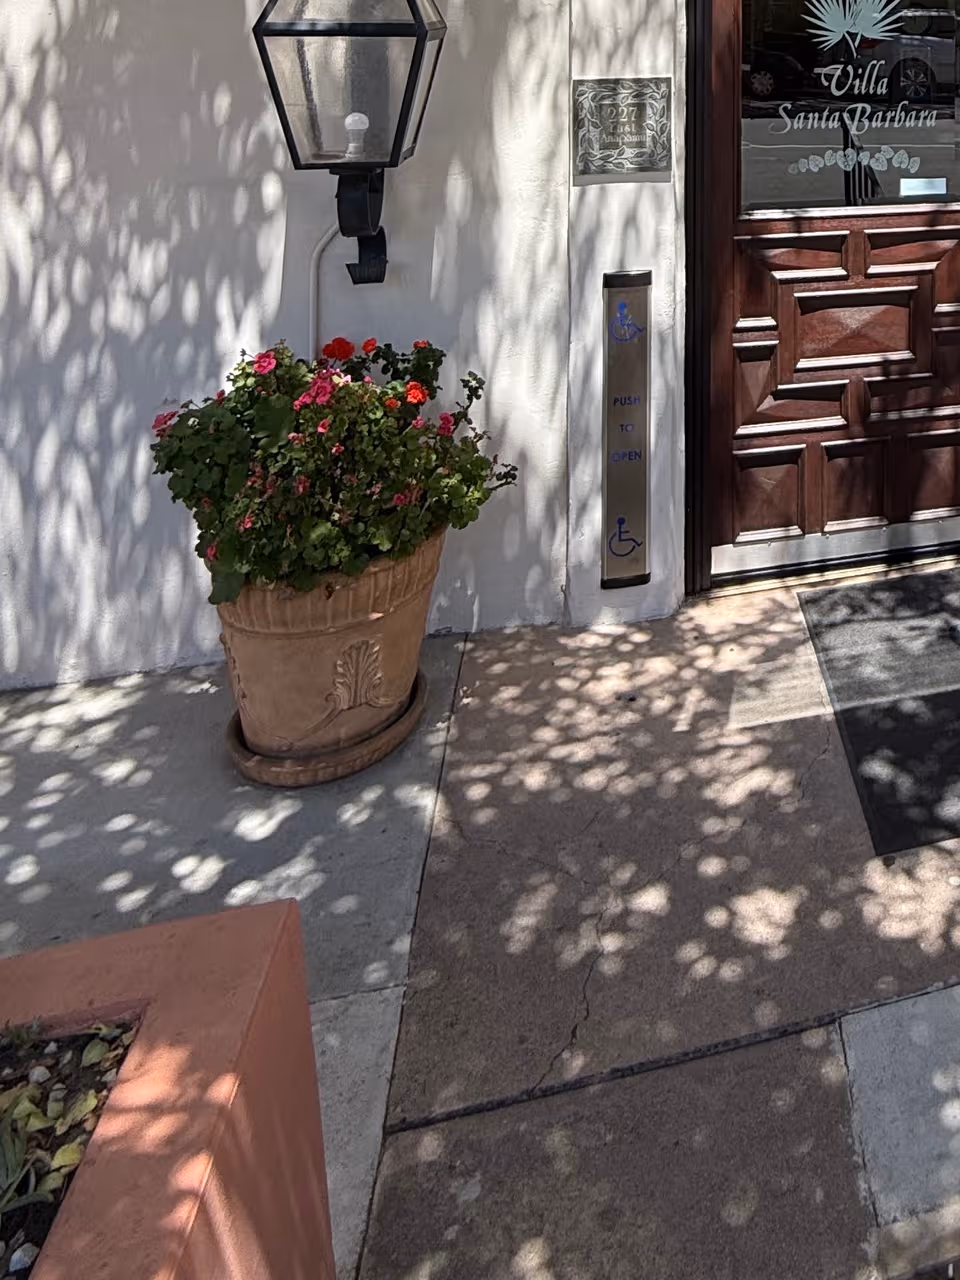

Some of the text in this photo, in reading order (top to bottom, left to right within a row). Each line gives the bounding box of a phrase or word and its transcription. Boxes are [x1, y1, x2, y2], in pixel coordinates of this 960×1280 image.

[821, 59, 889, 96] Villa
[608, 107, 637, 122] 227
[768, 100, 938, 135] Santa Barbara
[613, 396, 640, 406] PUSH
[619, 423, 635, 433] TO
[611, 449, 641, 463] OPEN
